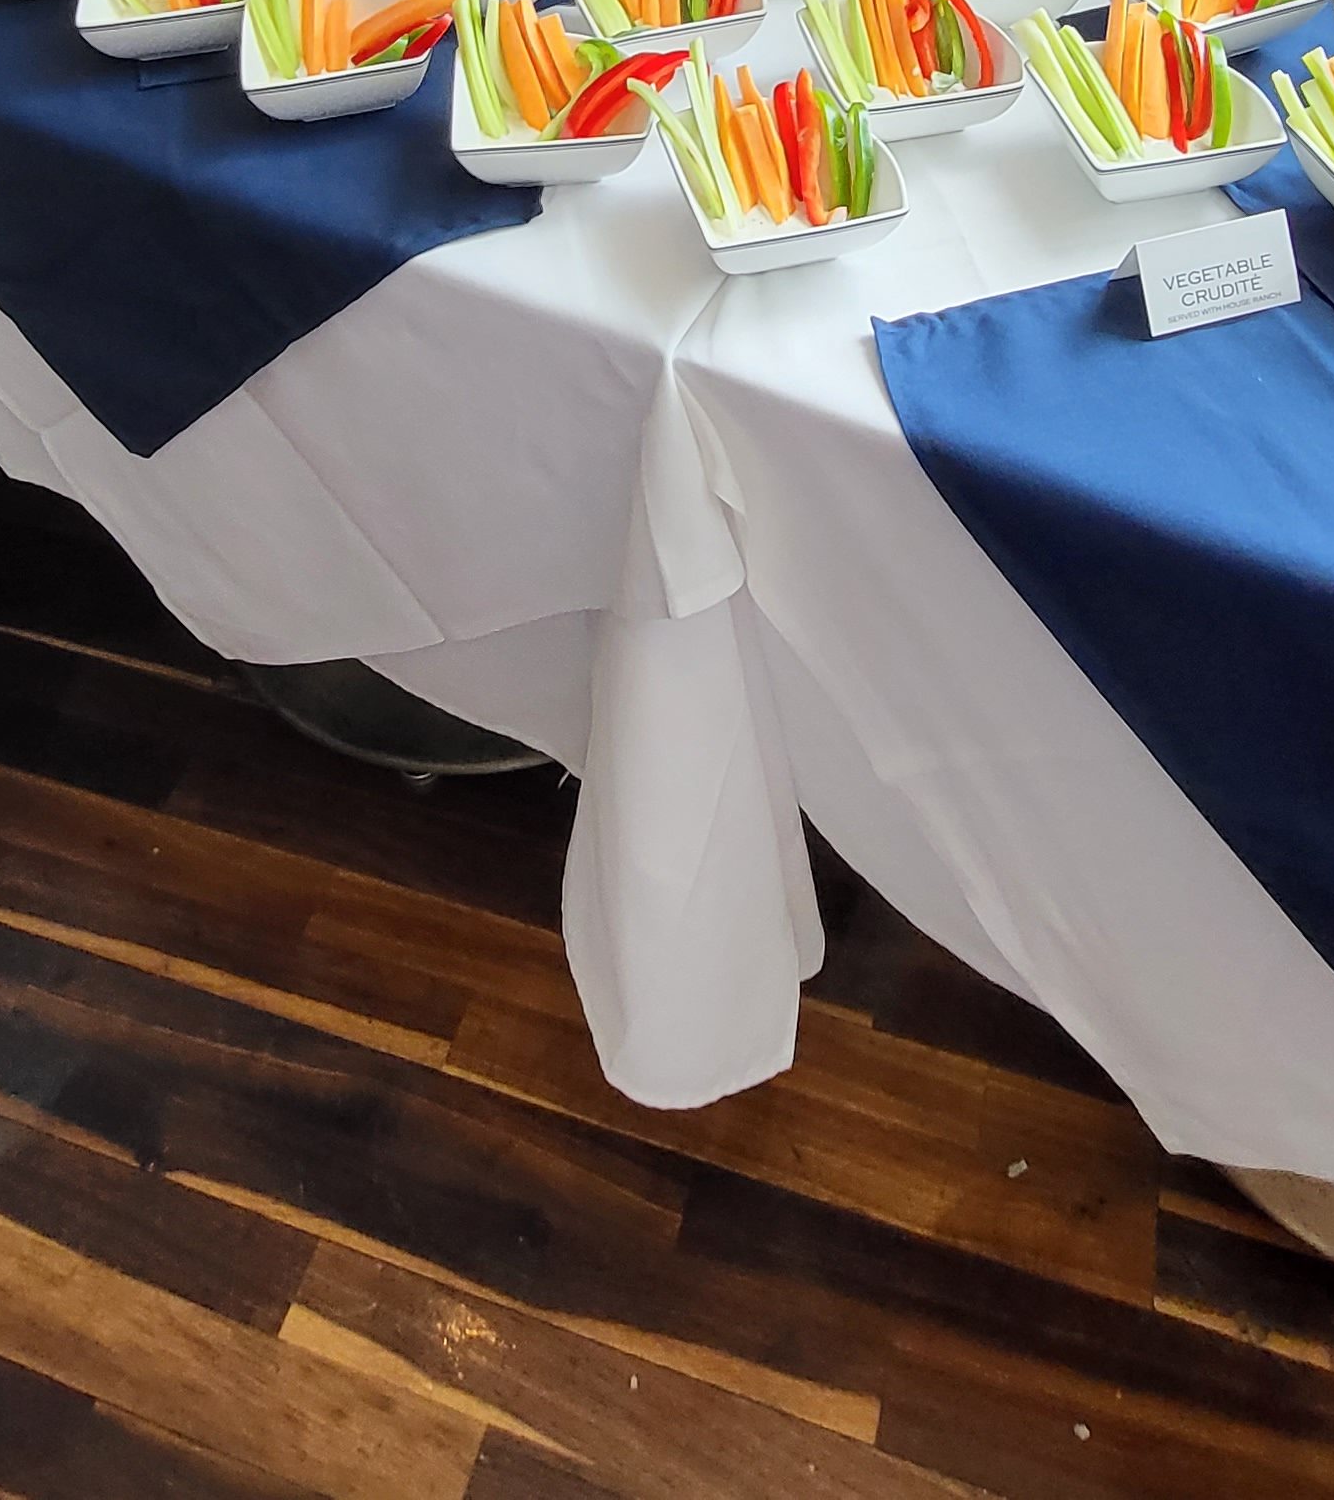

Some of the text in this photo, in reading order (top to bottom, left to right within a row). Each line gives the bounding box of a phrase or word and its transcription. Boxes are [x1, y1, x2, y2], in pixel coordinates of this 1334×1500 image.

[1163, 253, 1273, 290] VEGETABLE
[1181, 273, 1263, 307] CRUDITÉ
[1168, 291, 1282, 325] SERVED WITH HOUSE RANCH
